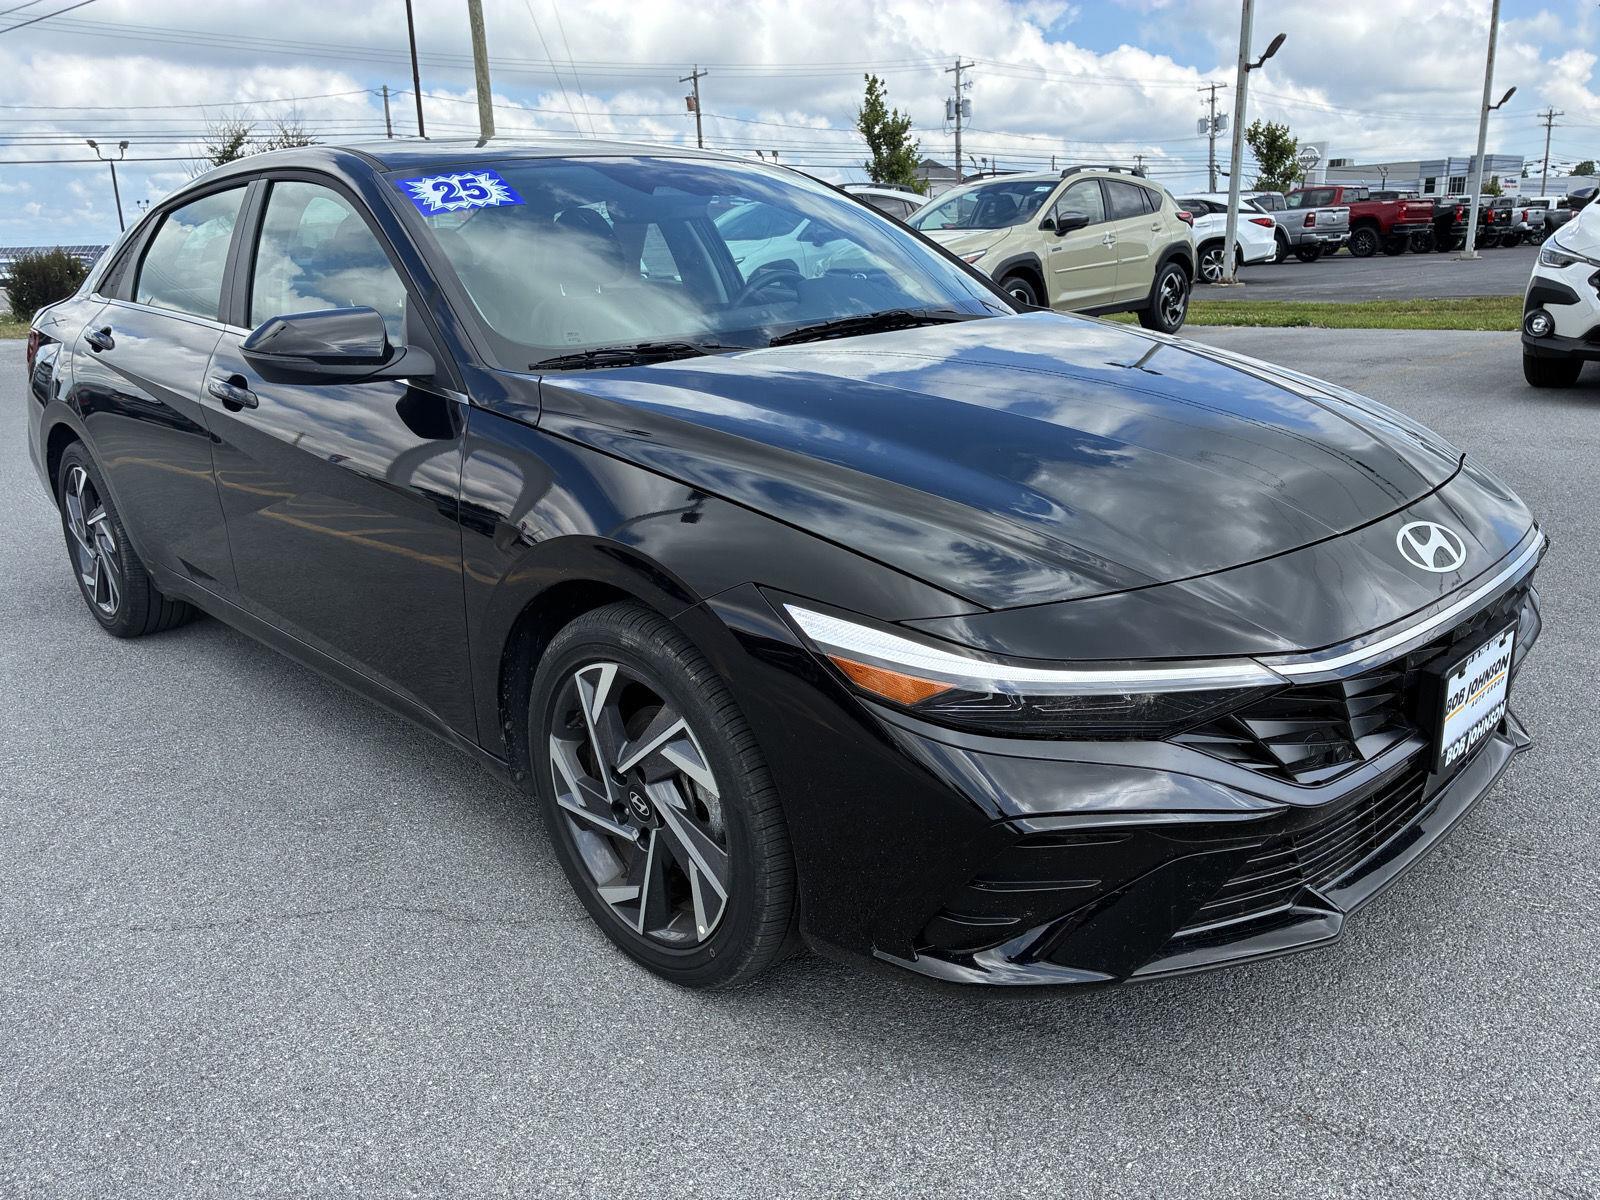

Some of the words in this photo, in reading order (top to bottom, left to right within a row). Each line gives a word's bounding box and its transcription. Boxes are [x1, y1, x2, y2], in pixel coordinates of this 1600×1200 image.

[431, 177, 489, 204] 25
[1446, 686, 1466, 713] BOB
[1465, 652, 1510, 705] JOHNSON
[1471, 692, 1485, 708] AUTO
[1487, 676, 1505, 694] GROUP
[1445, 735, 1466, 768] BOB
[1465, 699, 1507, 754] JOHNSON
